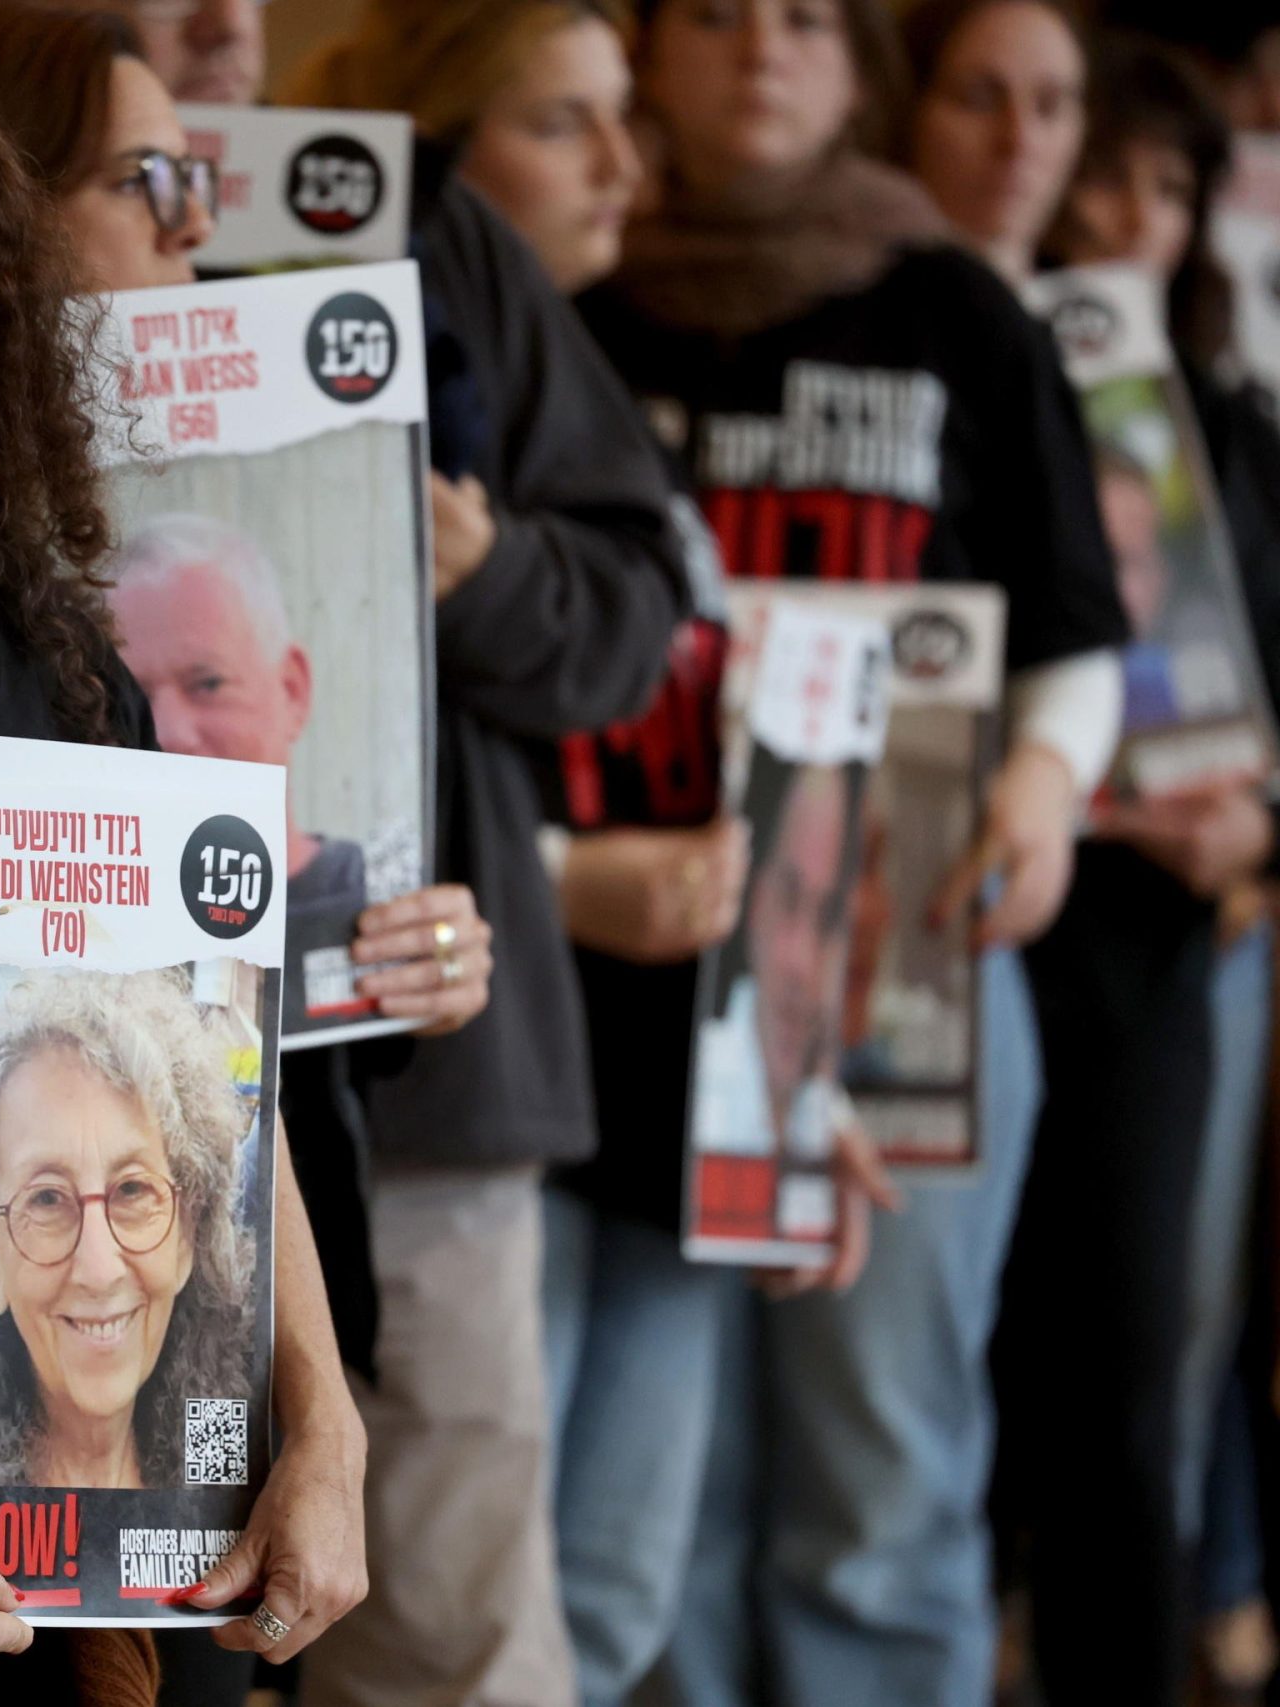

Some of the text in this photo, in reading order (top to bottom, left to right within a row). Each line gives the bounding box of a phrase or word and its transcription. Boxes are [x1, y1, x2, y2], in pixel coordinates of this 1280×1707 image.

[319, 319, 390, 378] 150
[180, 351, 259, 394] WEISS
[94, 813, 142, 856] ג'ודי
[29, 860, 150, 906] WEINSTEIN
[197, 845, 263, 910] 150
[41, 907, 86, 958] (70)
[120, 1528, 177, 1555] HOSTAGES
[180, 1529, 203, 1555] AND
[121, 1554, 197, 1589] FAMILIES
